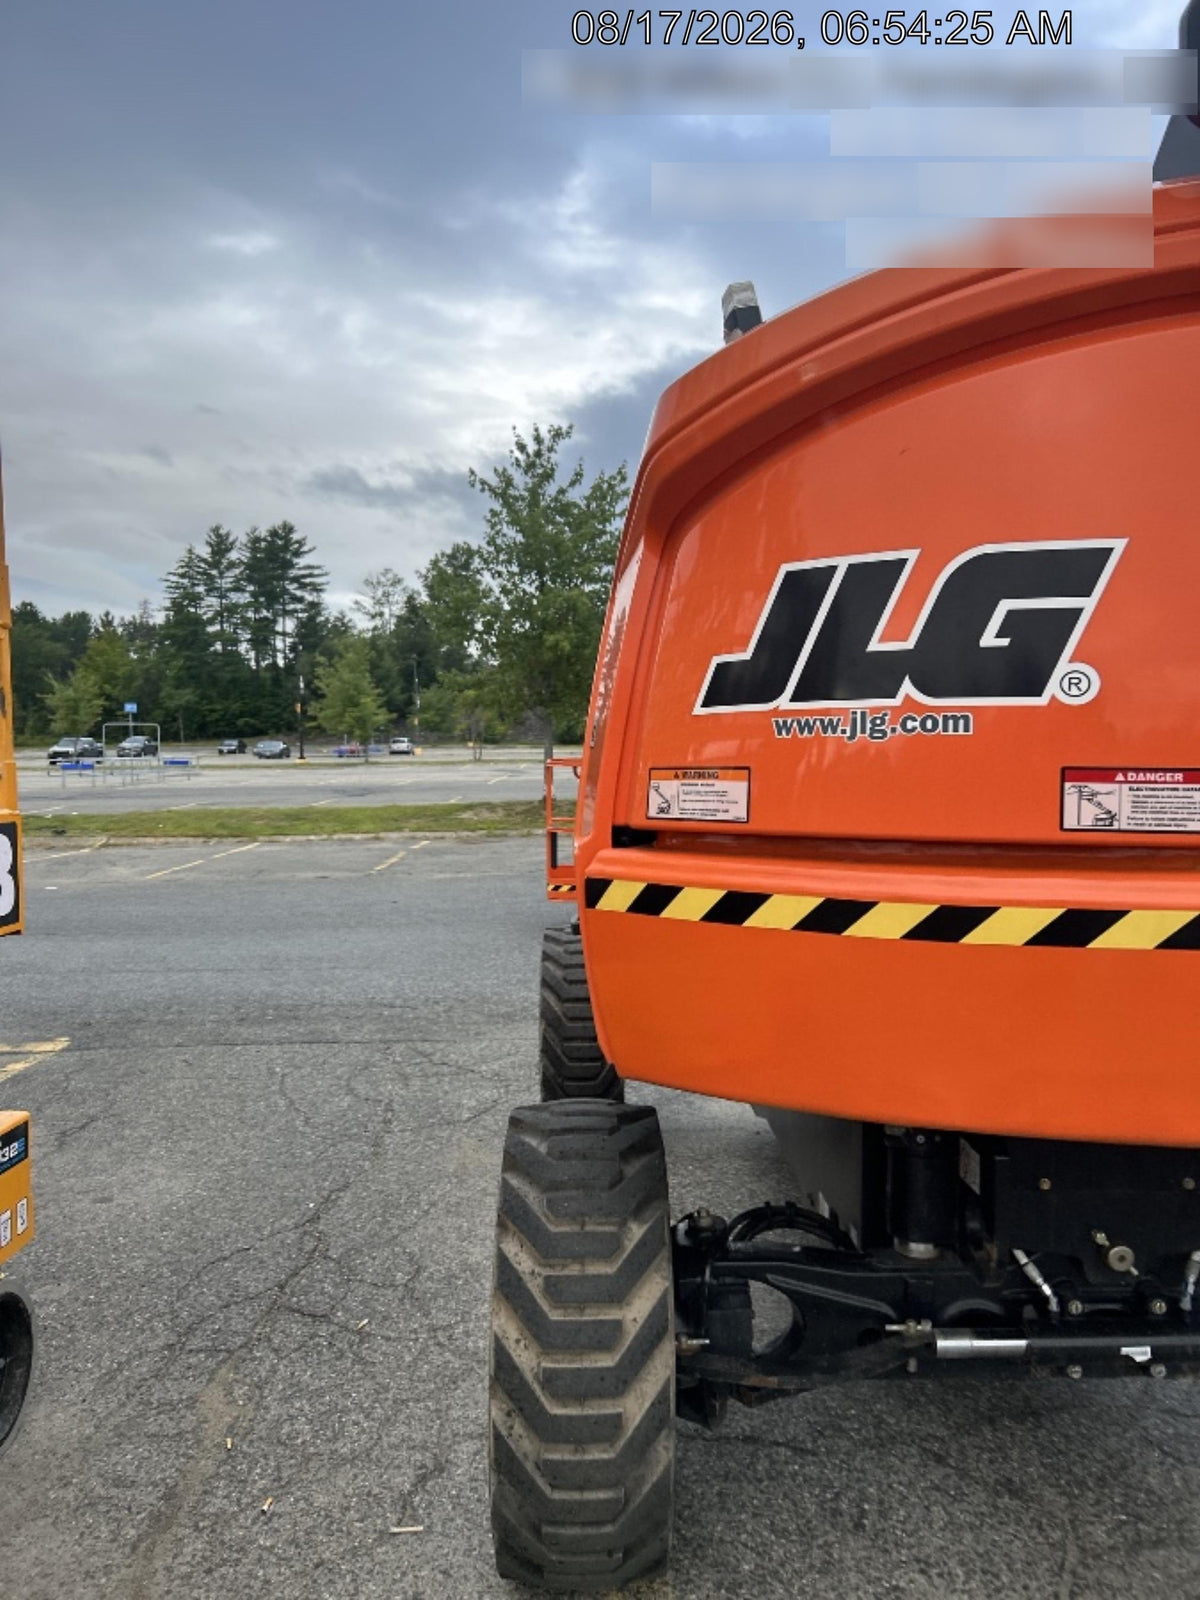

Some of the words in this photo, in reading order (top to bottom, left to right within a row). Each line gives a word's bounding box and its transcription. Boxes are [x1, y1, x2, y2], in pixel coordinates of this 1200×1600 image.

[692, 537, 1129, 714] JLG
[772, 709, 974, 743] www.jlg.com
[1127, 772, 1184, 782] DANGER
